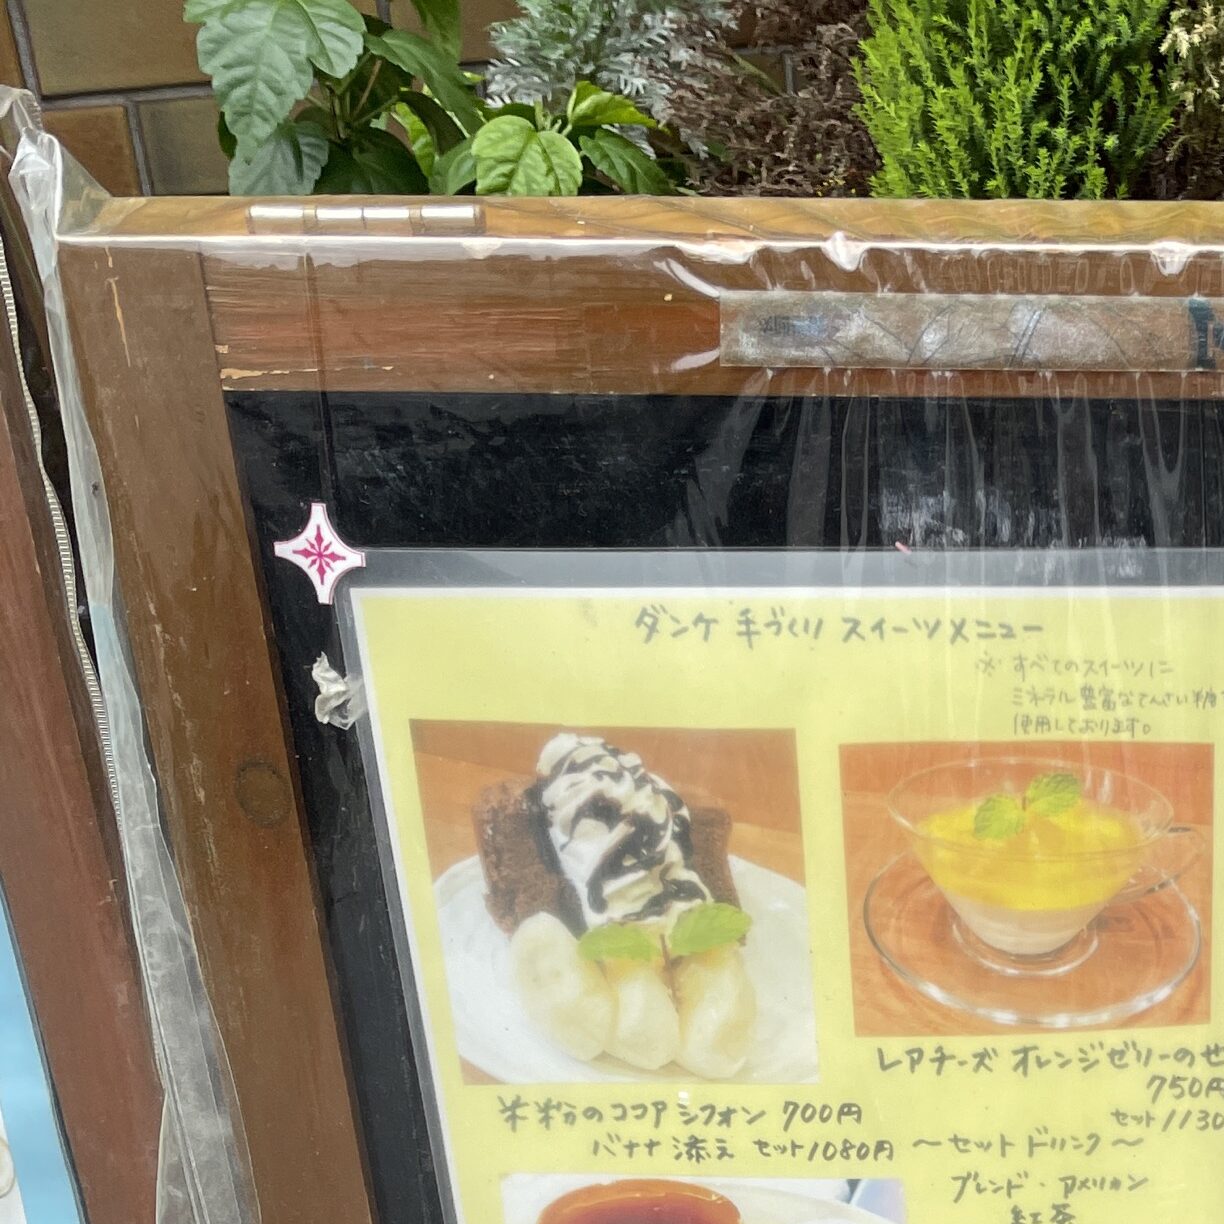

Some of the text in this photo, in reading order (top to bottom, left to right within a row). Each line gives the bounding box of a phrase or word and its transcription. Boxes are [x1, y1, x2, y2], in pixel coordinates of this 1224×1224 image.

[634, 606, 719, 645] ダンケ
[841, 615, 1045, 646] スイーツメニュー
[876, 1045, 998, 1076] レアチーズ
[781, 1099, 864, 1132] 700円
